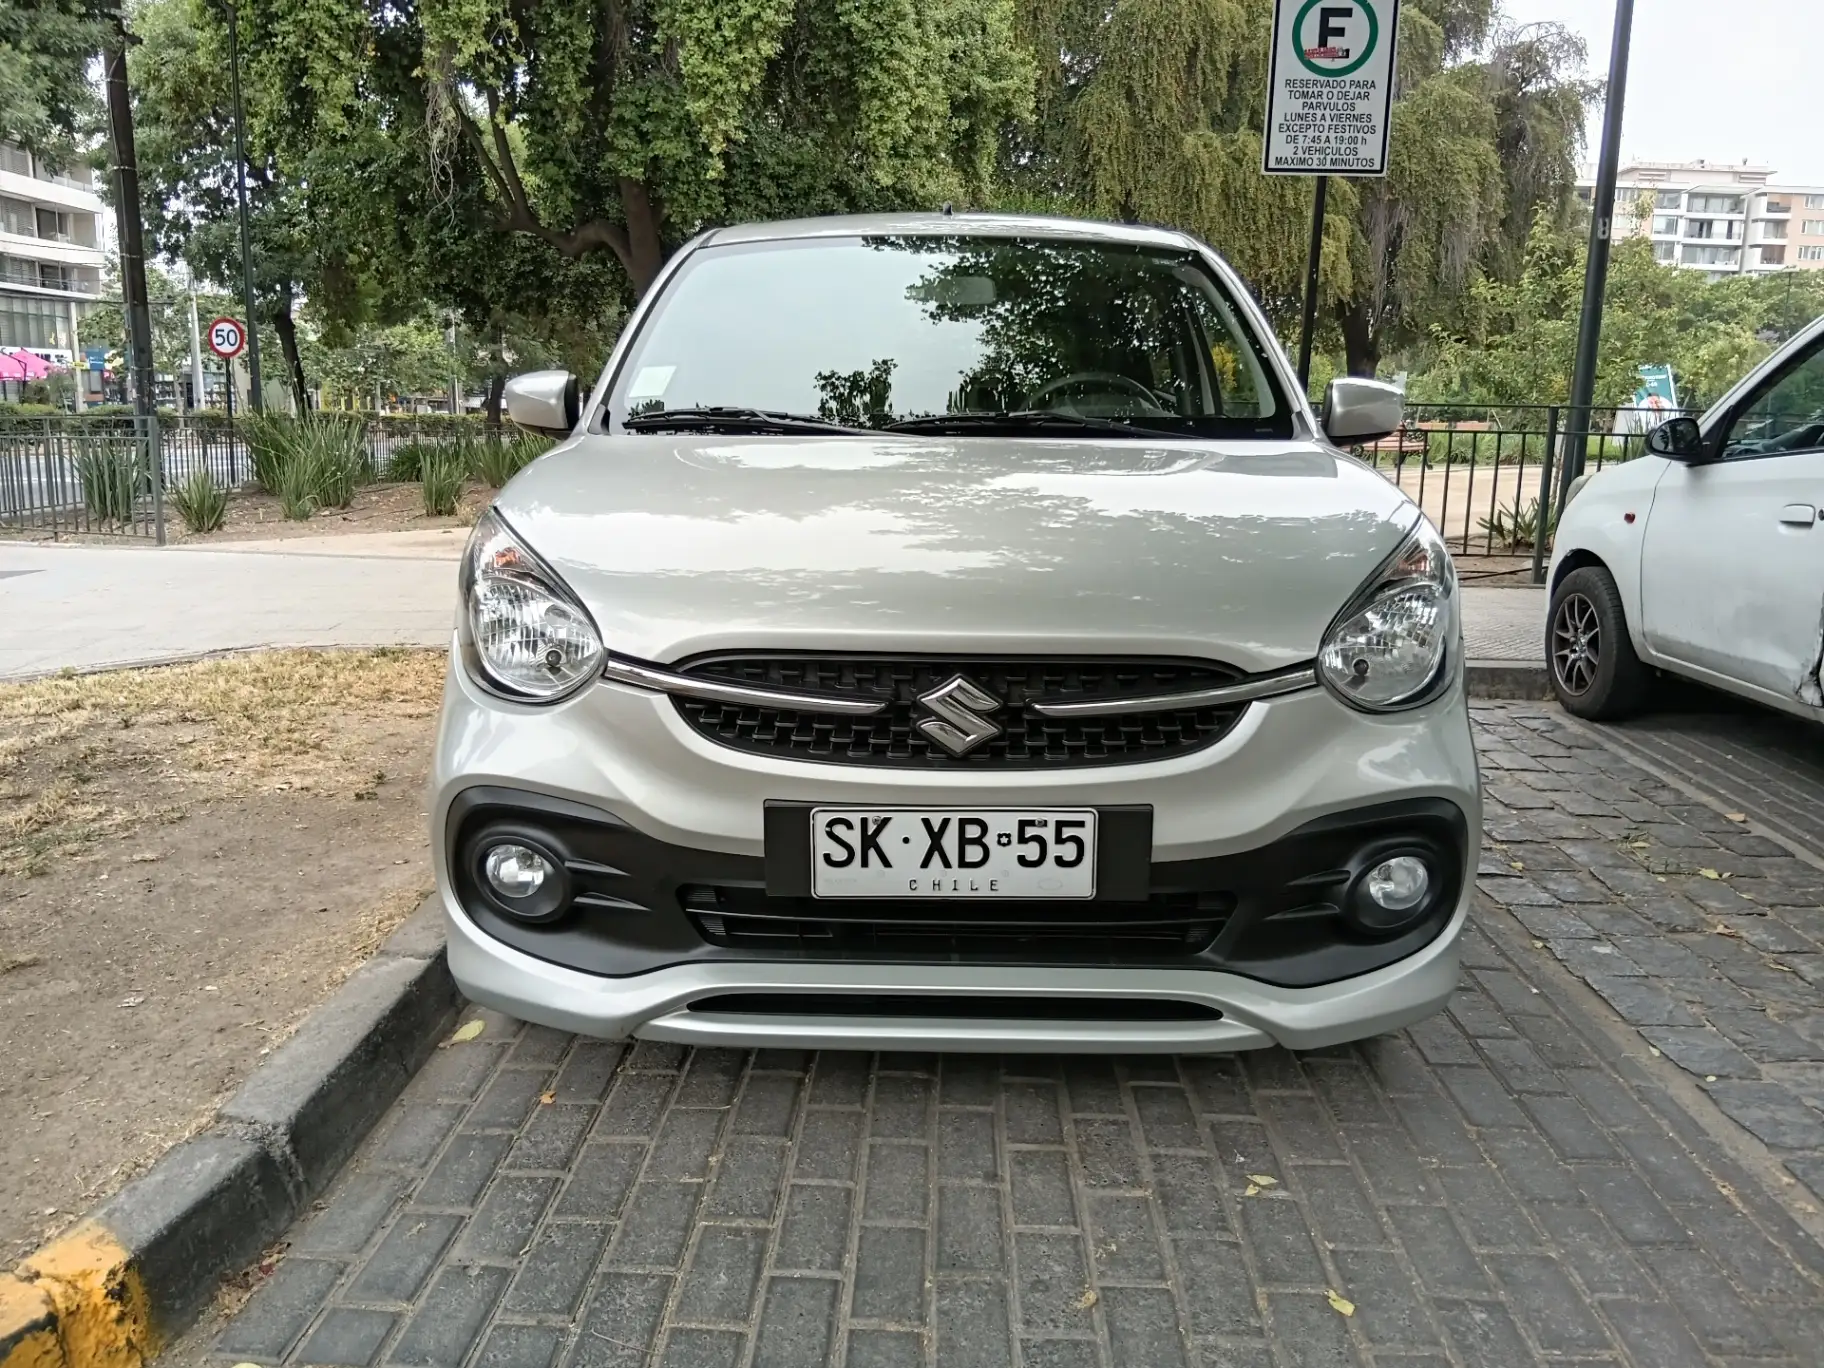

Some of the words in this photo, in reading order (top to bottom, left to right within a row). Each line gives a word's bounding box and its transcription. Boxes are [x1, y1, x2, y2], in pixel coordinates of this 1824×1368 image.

[1285, 79, 1346, 89] RESERVADO
[1349, 80, 1376, 90] PARA
[1288, 90, 1323, 100] TOMAR
[1326, 91, 1334, 100] O
[1337, 91, 1370, 101] DEJAR
[1302, 101, 1356, 112] PARVULOS
[1284, 112, 1317, 122] LUNES
[1319, 113, 1327, 122] A
[1329, 113, 1372, 123] VIERNES
[1279, 123, 1325, 133] EXCEPTO
[1327, 124, 1376, 134] FESTIVOS
[1285, 135, 1299, 144] DE
[1302, 135, 1321, 144] 7:45
[1323, 135, 1331, 144] A
[1334, 136, 1359, 145] 19:00
[1361, 136, 1367, 145] h
[1293, 146, 1298, 155] 2
[1301, 146, 1358, 156] VEHICULOS
[1275, 156, 1314, 167] MAXIMO
[1316, 157, 1327, 167] 30
[1329, 157, 1375, 167] MINUTOS
[215, 328, 238, 347] 50
[908, 878, 1000, 892] CHILE
